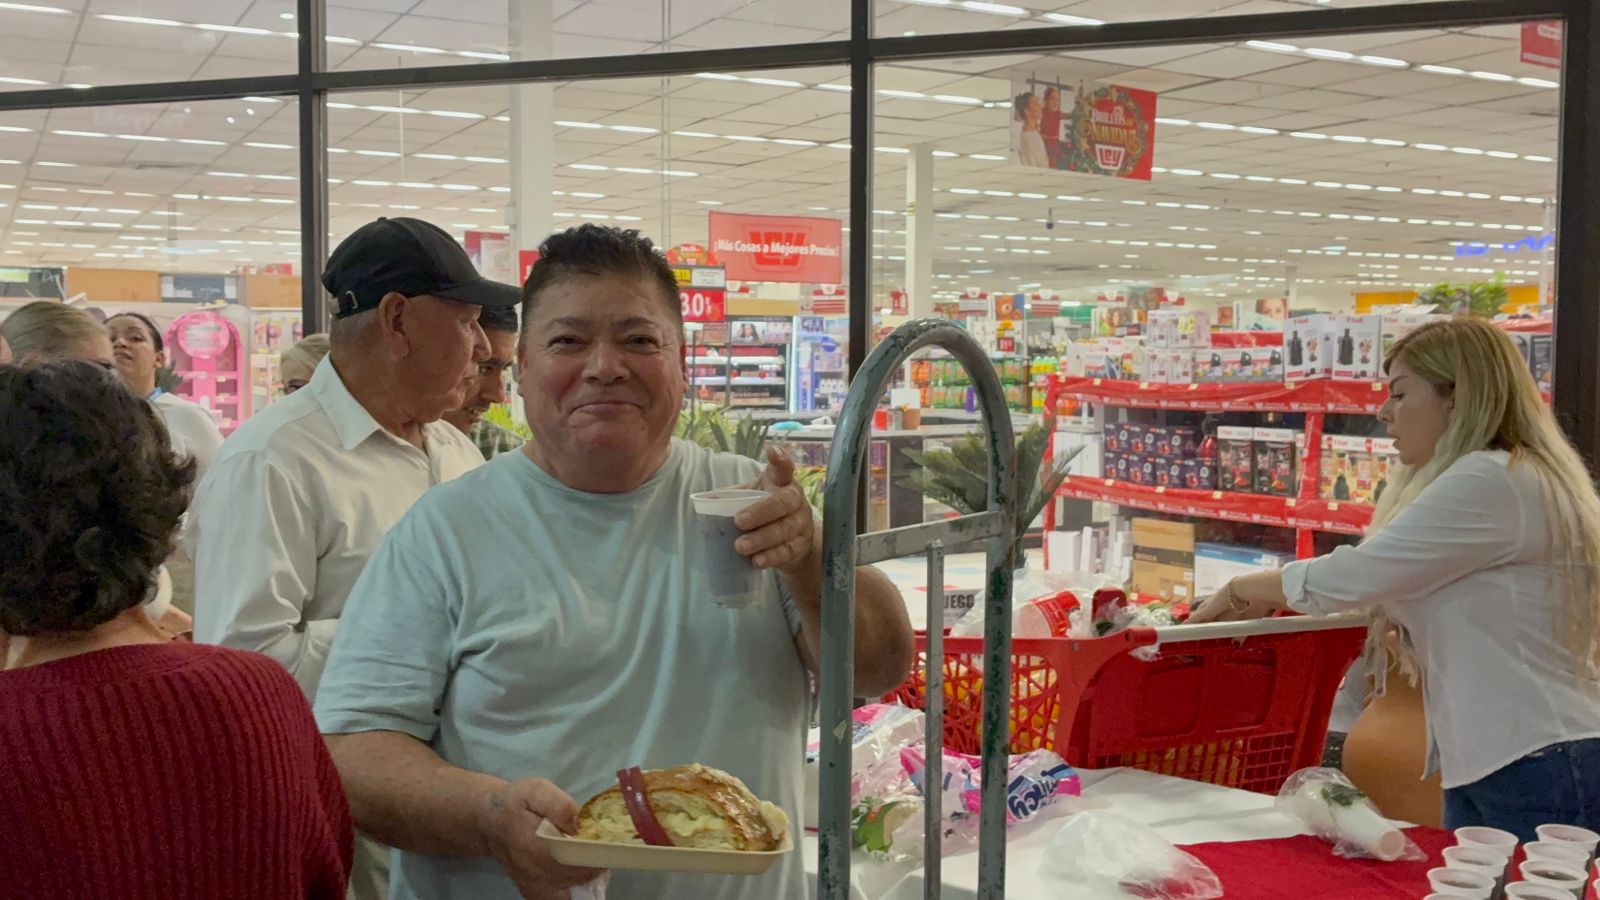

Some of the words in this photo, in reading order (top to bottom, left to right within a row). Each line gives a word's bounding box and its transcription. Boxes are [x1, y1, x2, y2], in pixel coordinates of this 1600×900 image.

[734, 240, 761, 253] Cosas
[763, 244, 769, 253] a
[770, 242, 808, 256] Mejores
